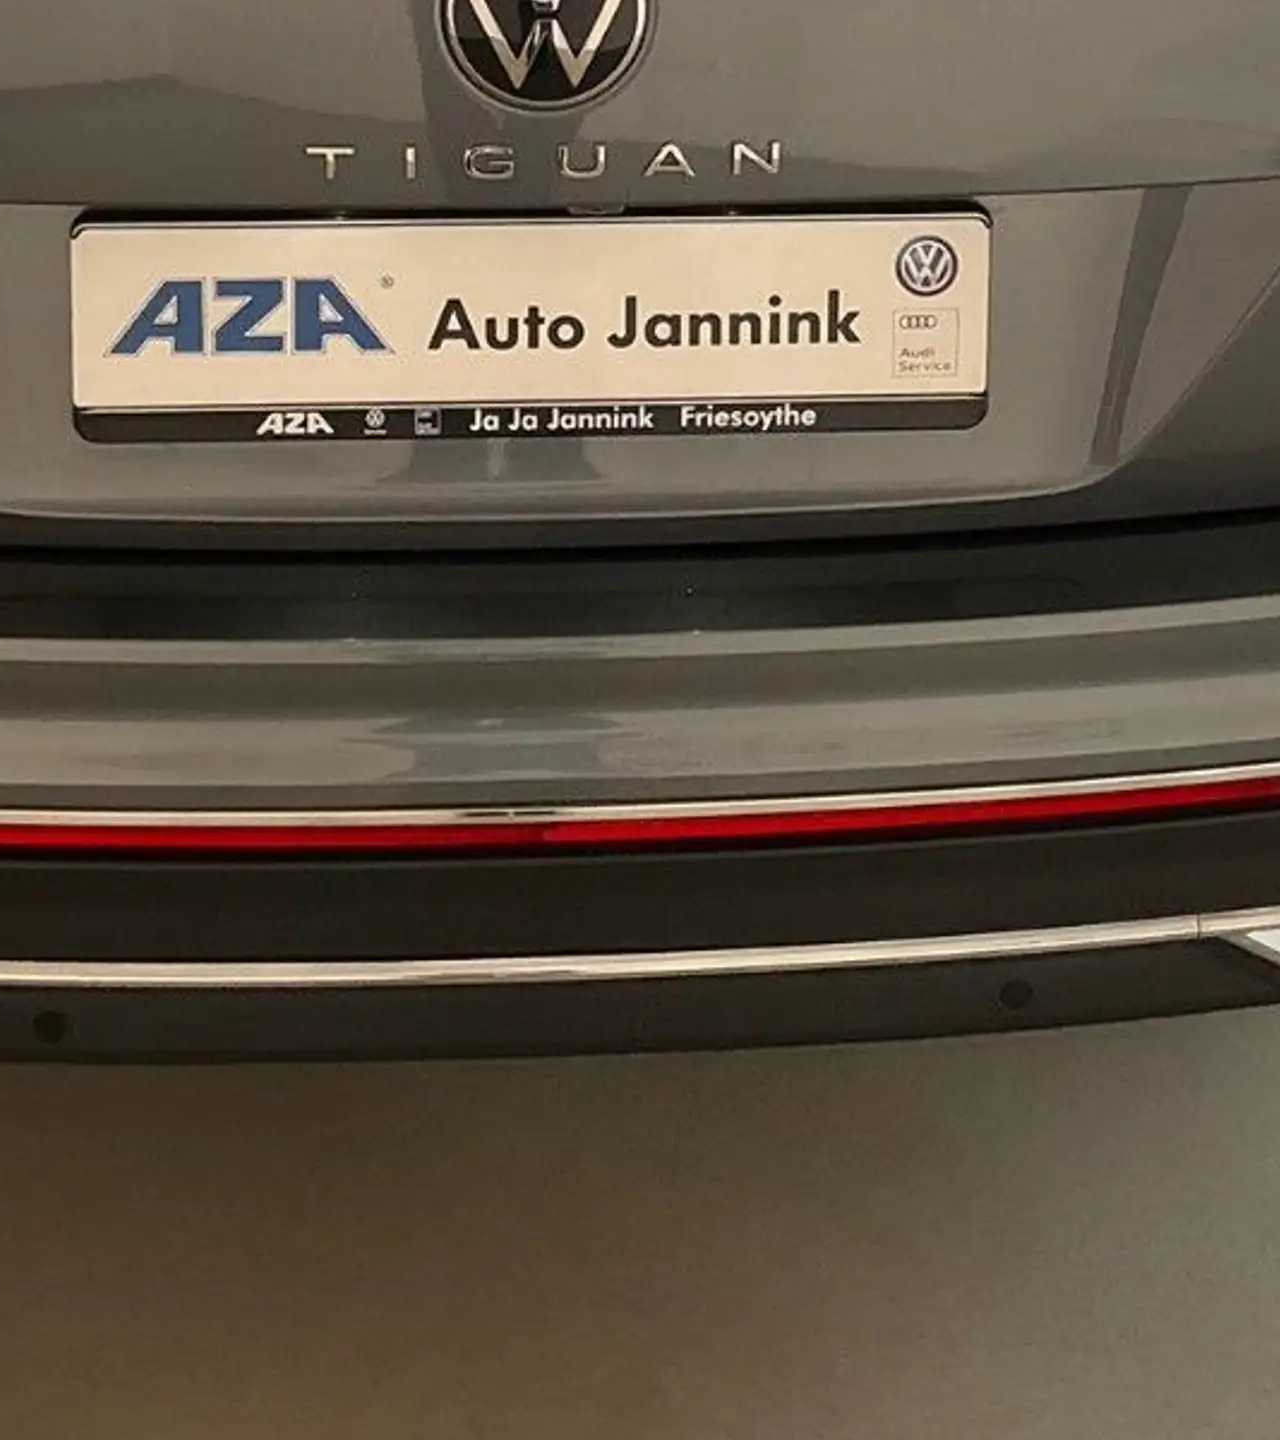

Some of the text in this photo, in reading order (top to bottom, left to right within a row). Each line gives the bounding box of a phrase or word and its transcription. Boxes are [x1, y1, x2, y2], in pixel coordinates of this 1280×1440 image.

[306, 140, 781, 180] TIGUAN
[104, 276, 862, 357] AZA Auto Jannink
[899, 347, 937, 359] Audi
[899, 360, 952, 373] Service
[256, 403, 818, 435] AZA Ja Ja Jannink Friesoythe
